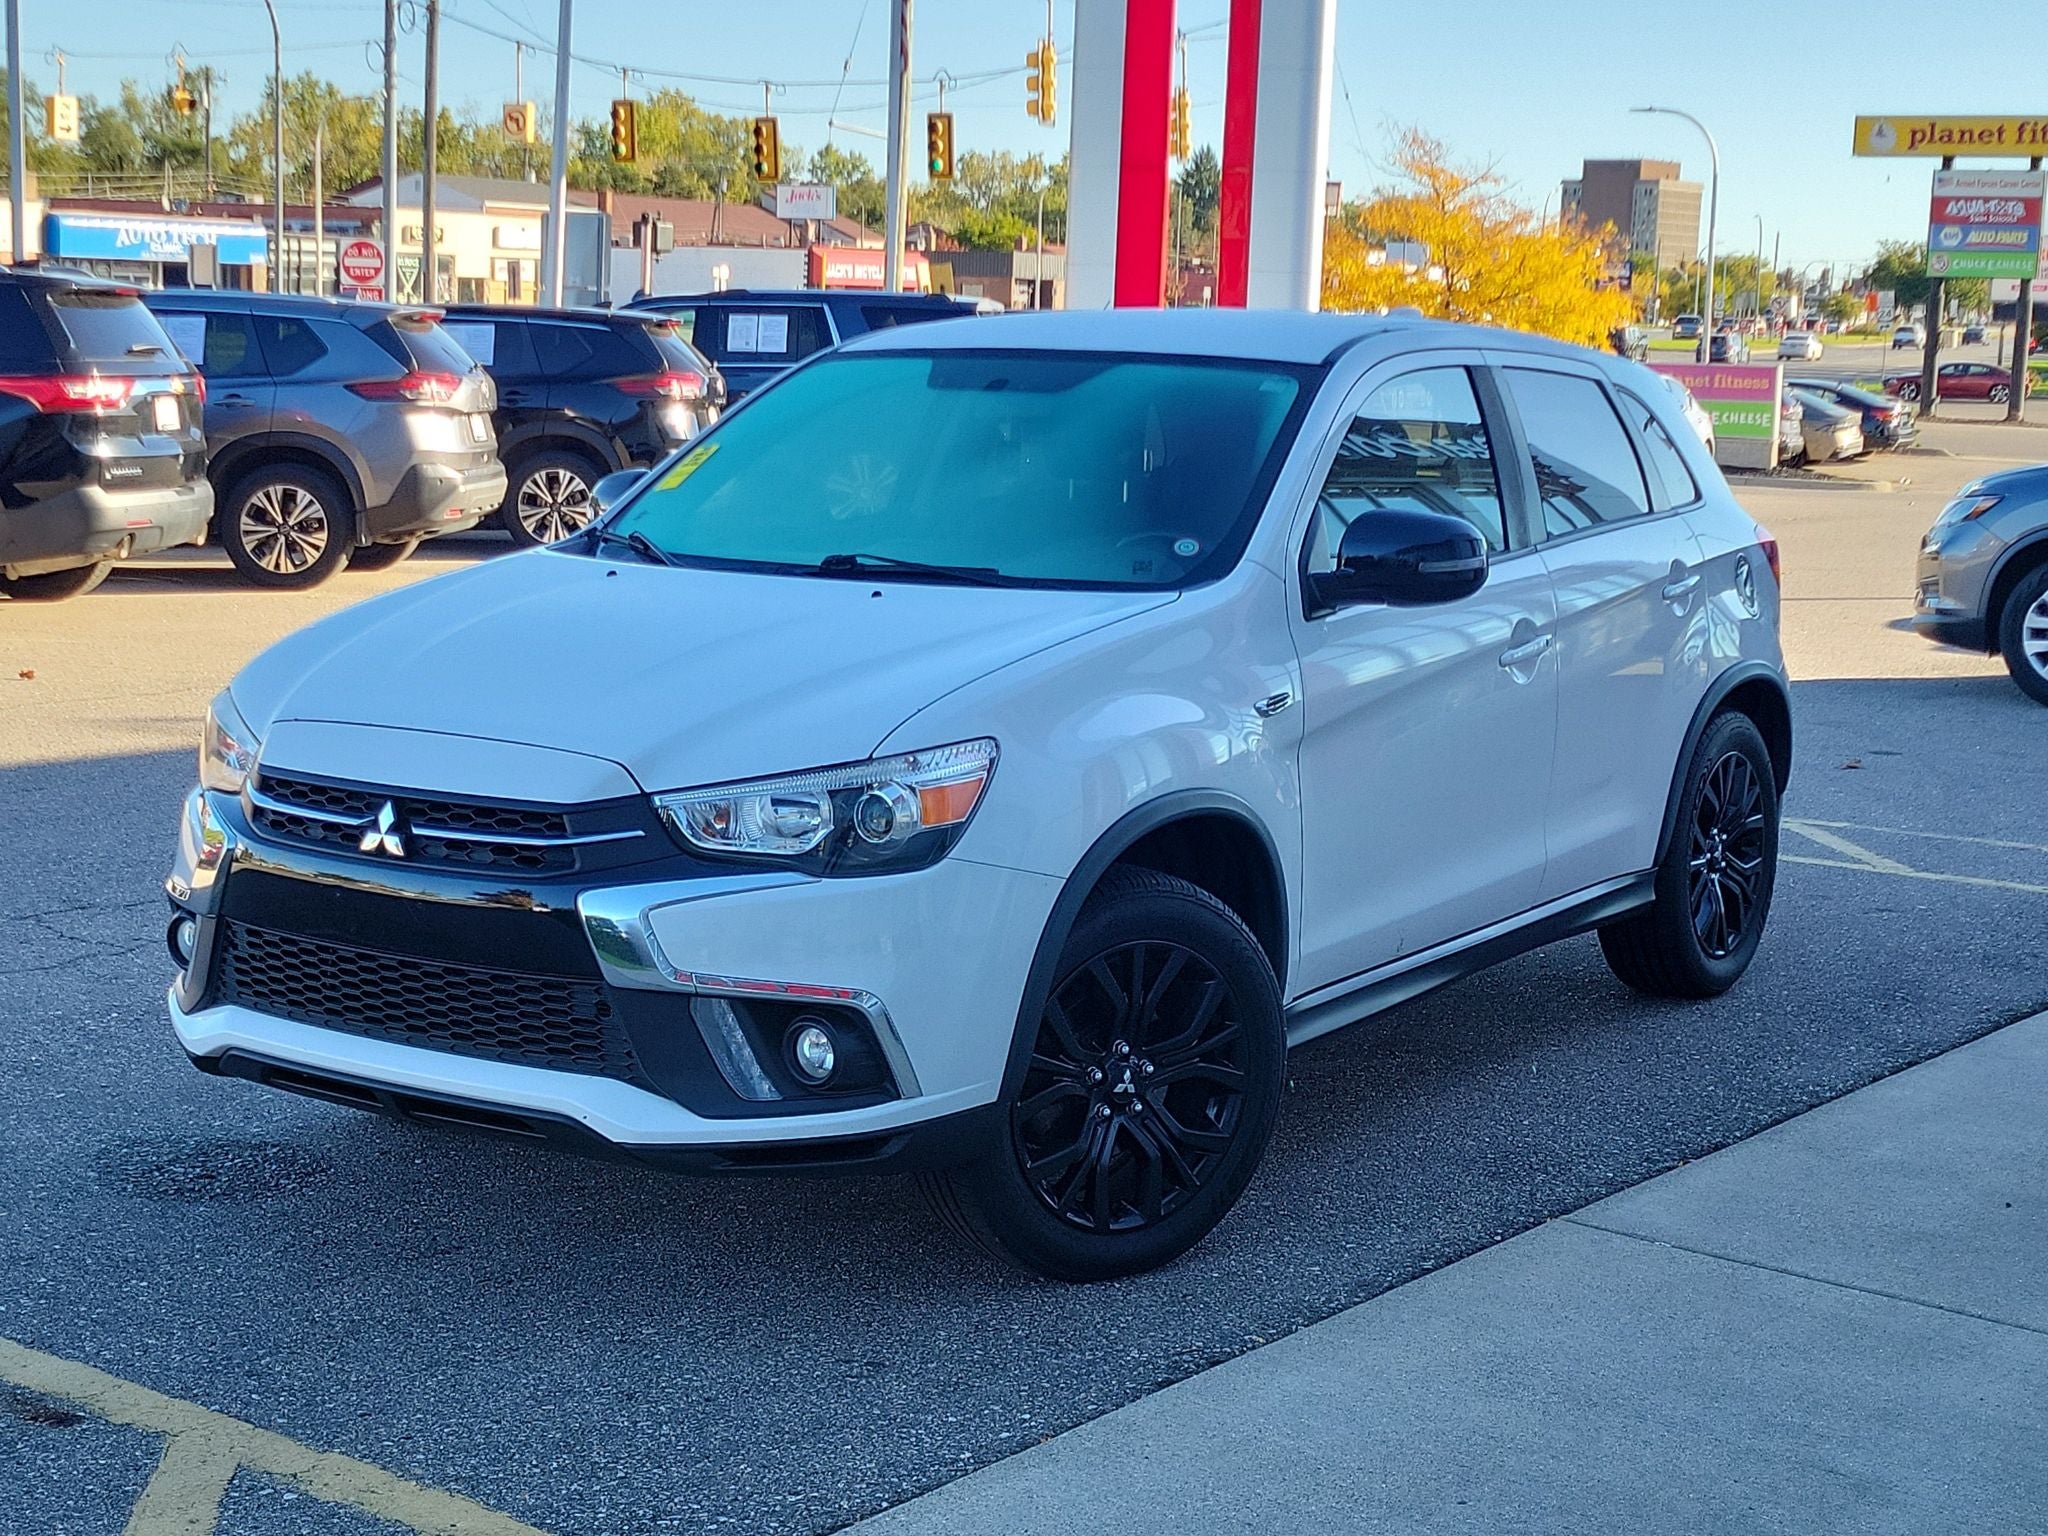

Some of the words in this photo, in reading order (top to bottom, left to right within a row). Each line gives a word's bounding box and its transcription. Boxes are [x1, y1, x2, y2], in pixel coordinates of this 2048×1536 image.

[1907, 121, 2006, 150] planet
[786, 189, 821, 204] Jack's
[115, 225, 167, 247] AUTO
[1965, 230, 1996, 244] AUTO
[347, 246, 359, 257] DO
[361, 247, 378, 258] NOT
[350, 268, 376, 278] ENTER
[855, 264, 885, 280] BICYCL
[1713, 374, 1769, 389] fitness
[1722, 411, 1771, 427] CHEESE
